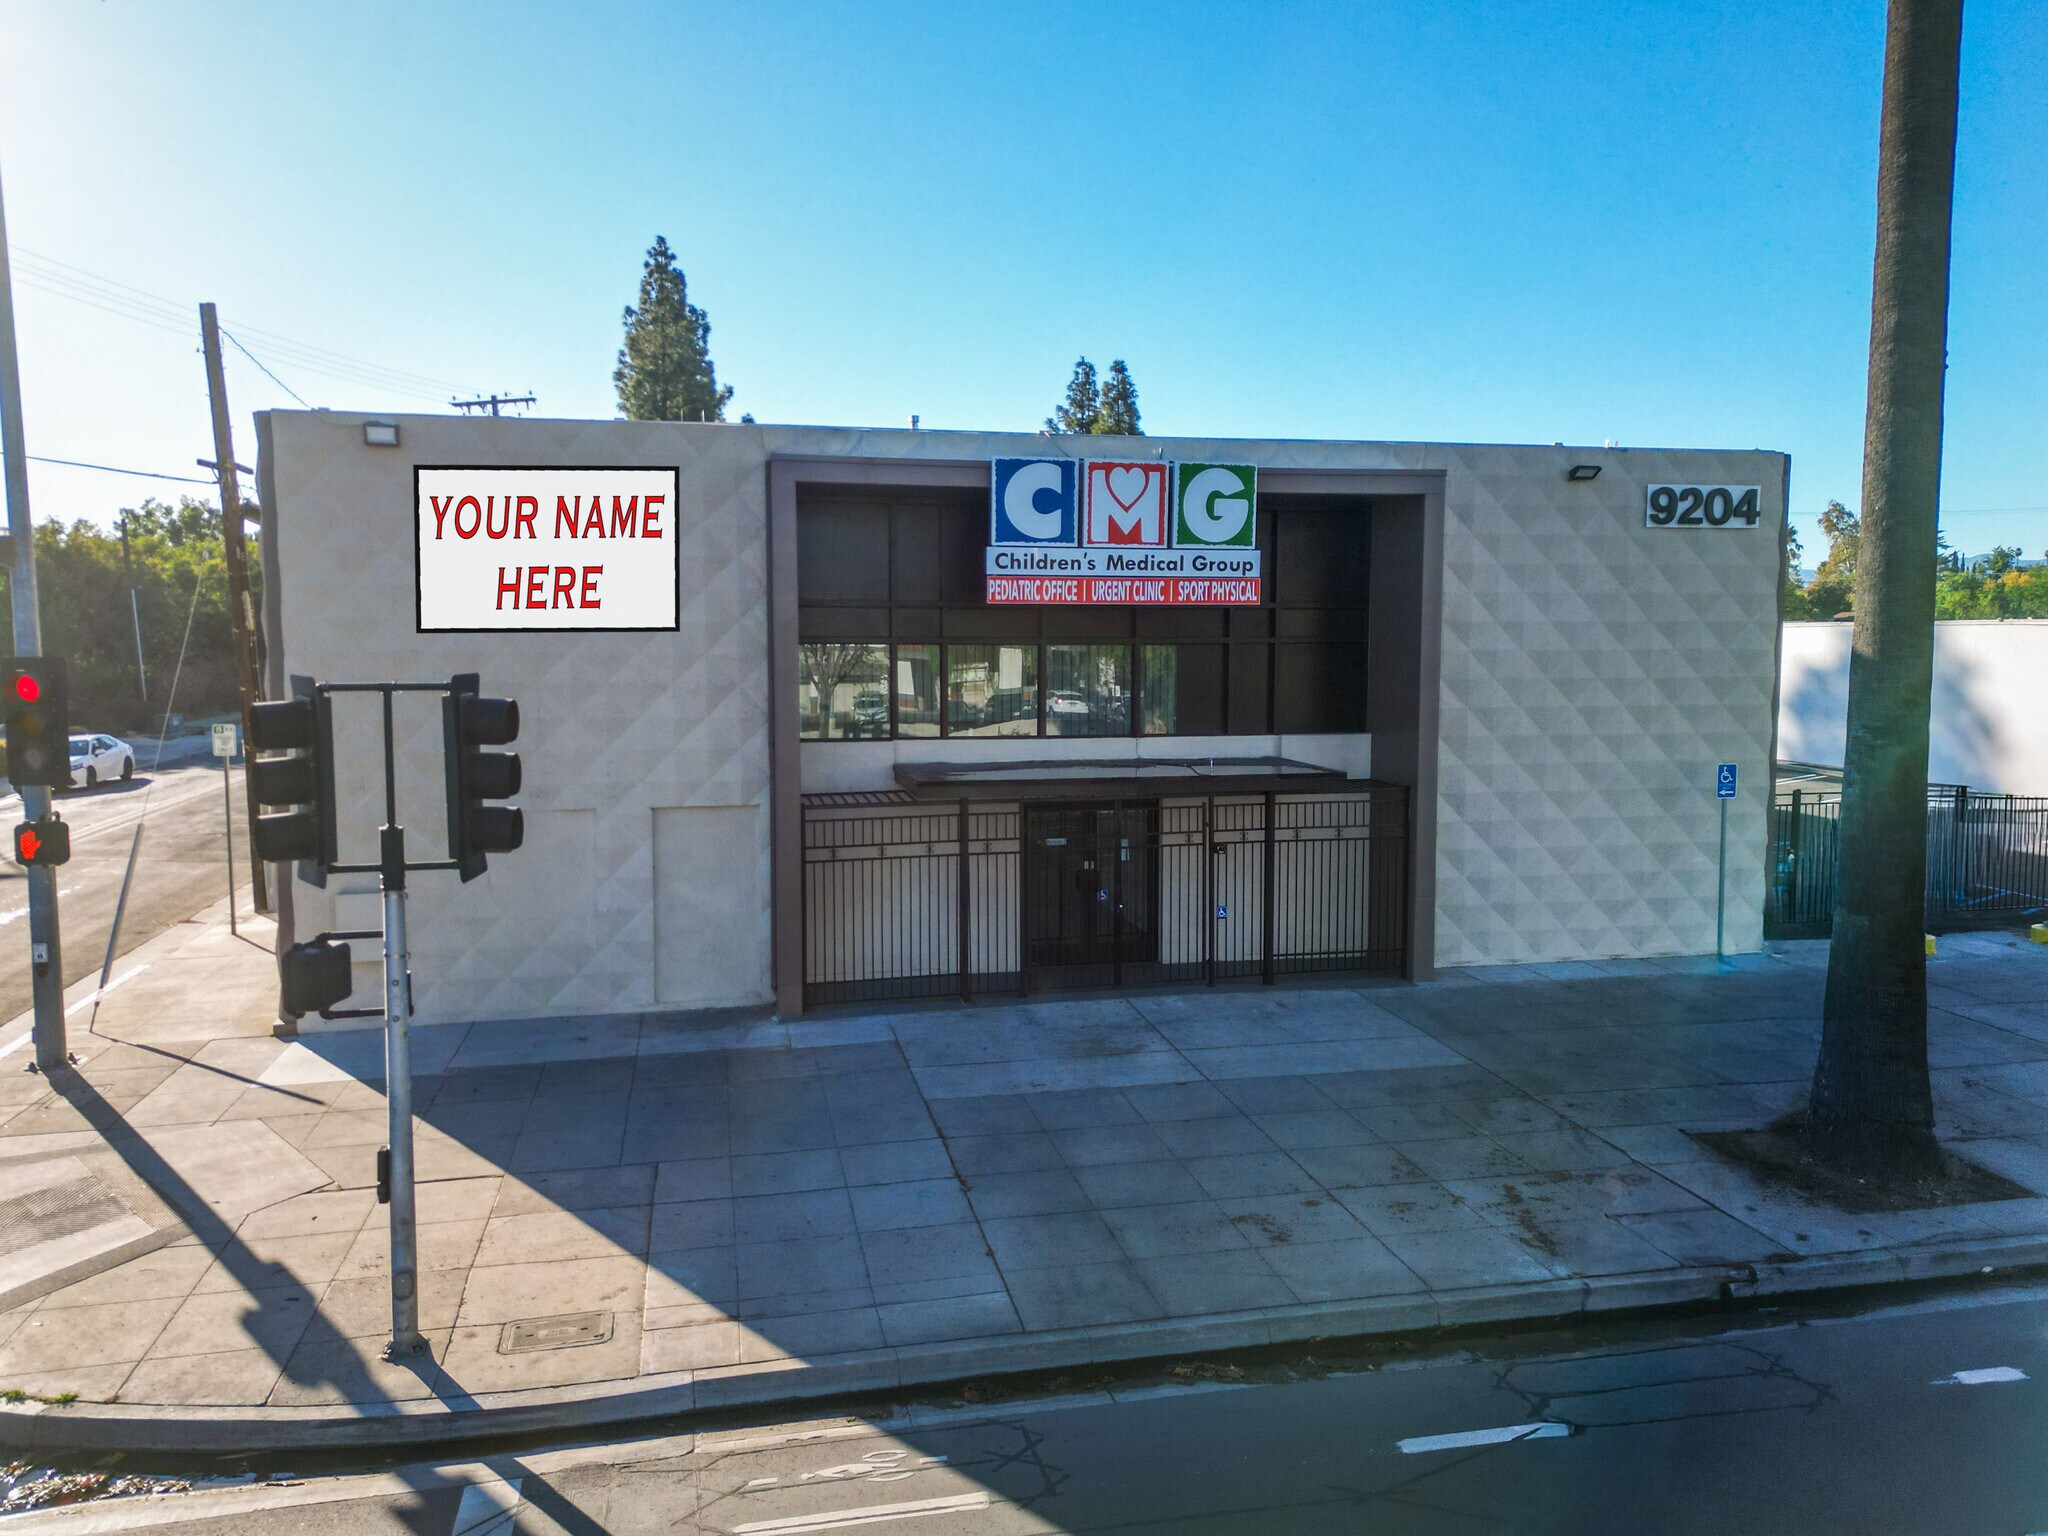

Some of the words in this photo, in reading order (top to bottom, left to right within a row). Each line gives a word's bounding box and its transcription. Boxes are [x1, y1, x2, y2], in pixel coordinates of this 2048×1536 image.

[429, 495, 539, 540] YOUR
[554, 494, 665, 539] NAME
[1649, 486, 1761, 526] 9204
[994, 552, 1096, 571] Children's
[1106, 554, 1184, 572] Medical
[1192, 555, 1254, 576] Group
[495, 564, 604, 610] HERE
[989, 579, 1041, 601] PEDIATRIC
[1043, 580, 1078, 601] OFFICE
[1091, 580, 1131, 601] URGENT
[1132, 580, 1165, 602] CLINIC
[1178, 581, 1210, 602] SPORT
[1211, 581, 1257, 602] PHYSICAL
